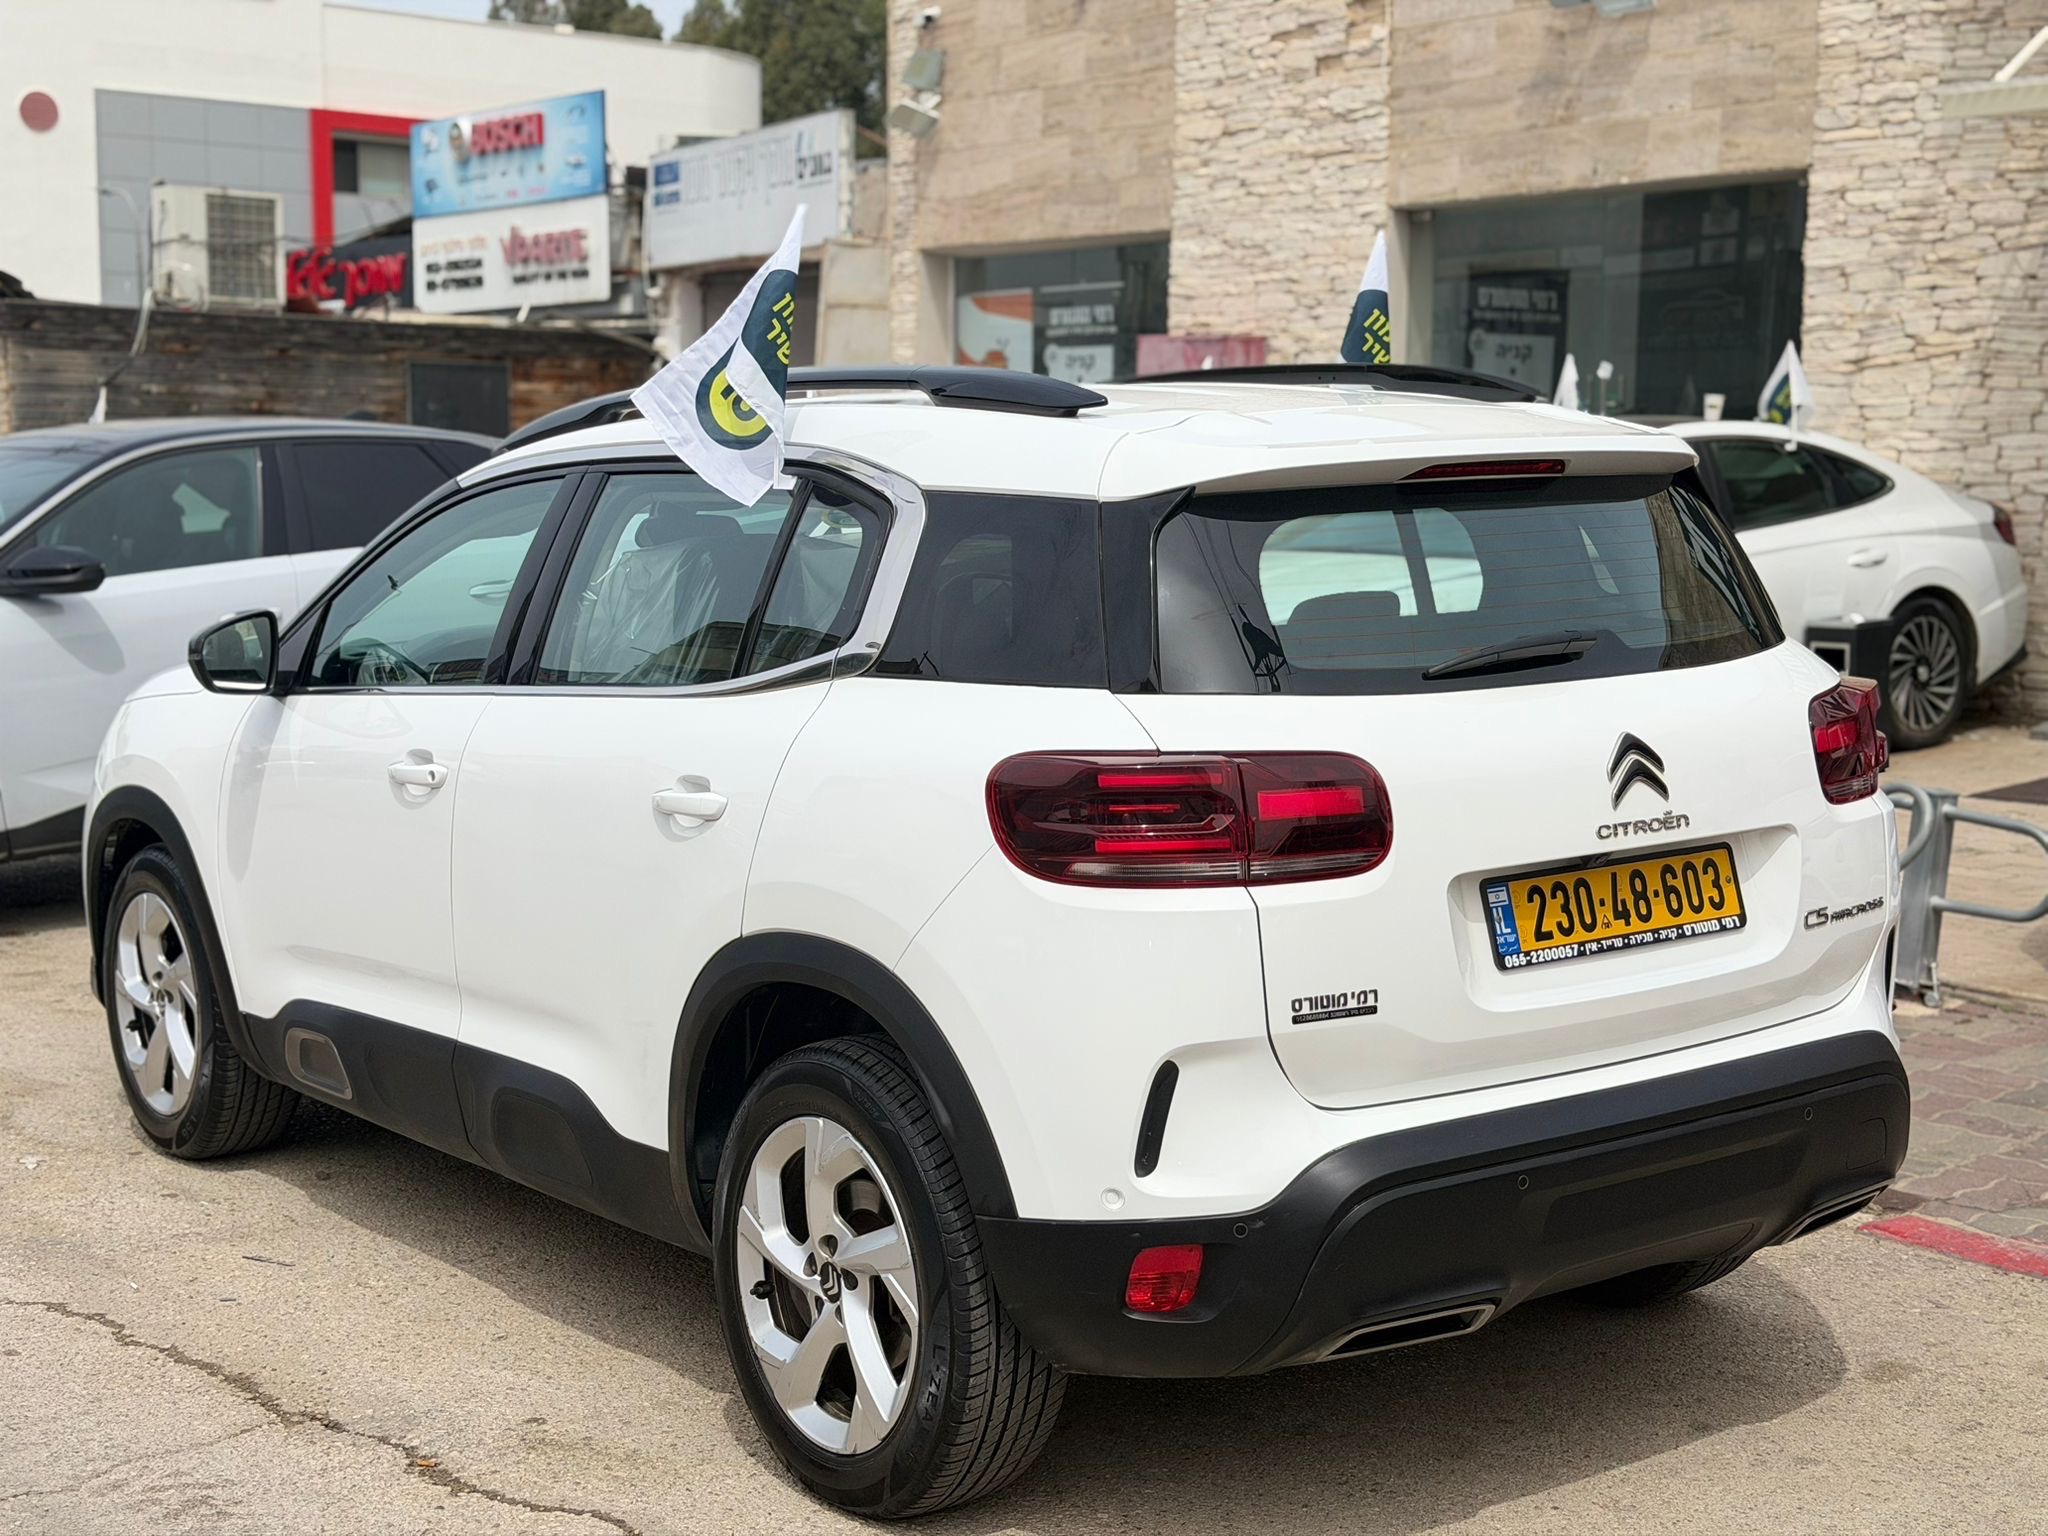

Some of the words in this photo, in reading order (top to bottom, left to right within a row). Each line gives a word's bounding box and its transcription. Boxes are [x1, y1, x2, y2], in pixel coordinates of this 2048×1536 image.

[471, 112, 543, 155] BOSCH
[1722, 915, 1740, 928] רמי
[1804, 906, 1829, 930] C5
[1830, 896, 1884, 923] AIRCROSS
[1658, 929, 1678, 941] קניה
[1683, 919, 1720, 936] מוטורס
[1629, 932, 1654, 945] מכירה
[1504, 945, 1579, 968] 055-2200057
[1291, 992, 1348, 1013] מוטורס
[1351, 988, 1378, 1005] רמי
